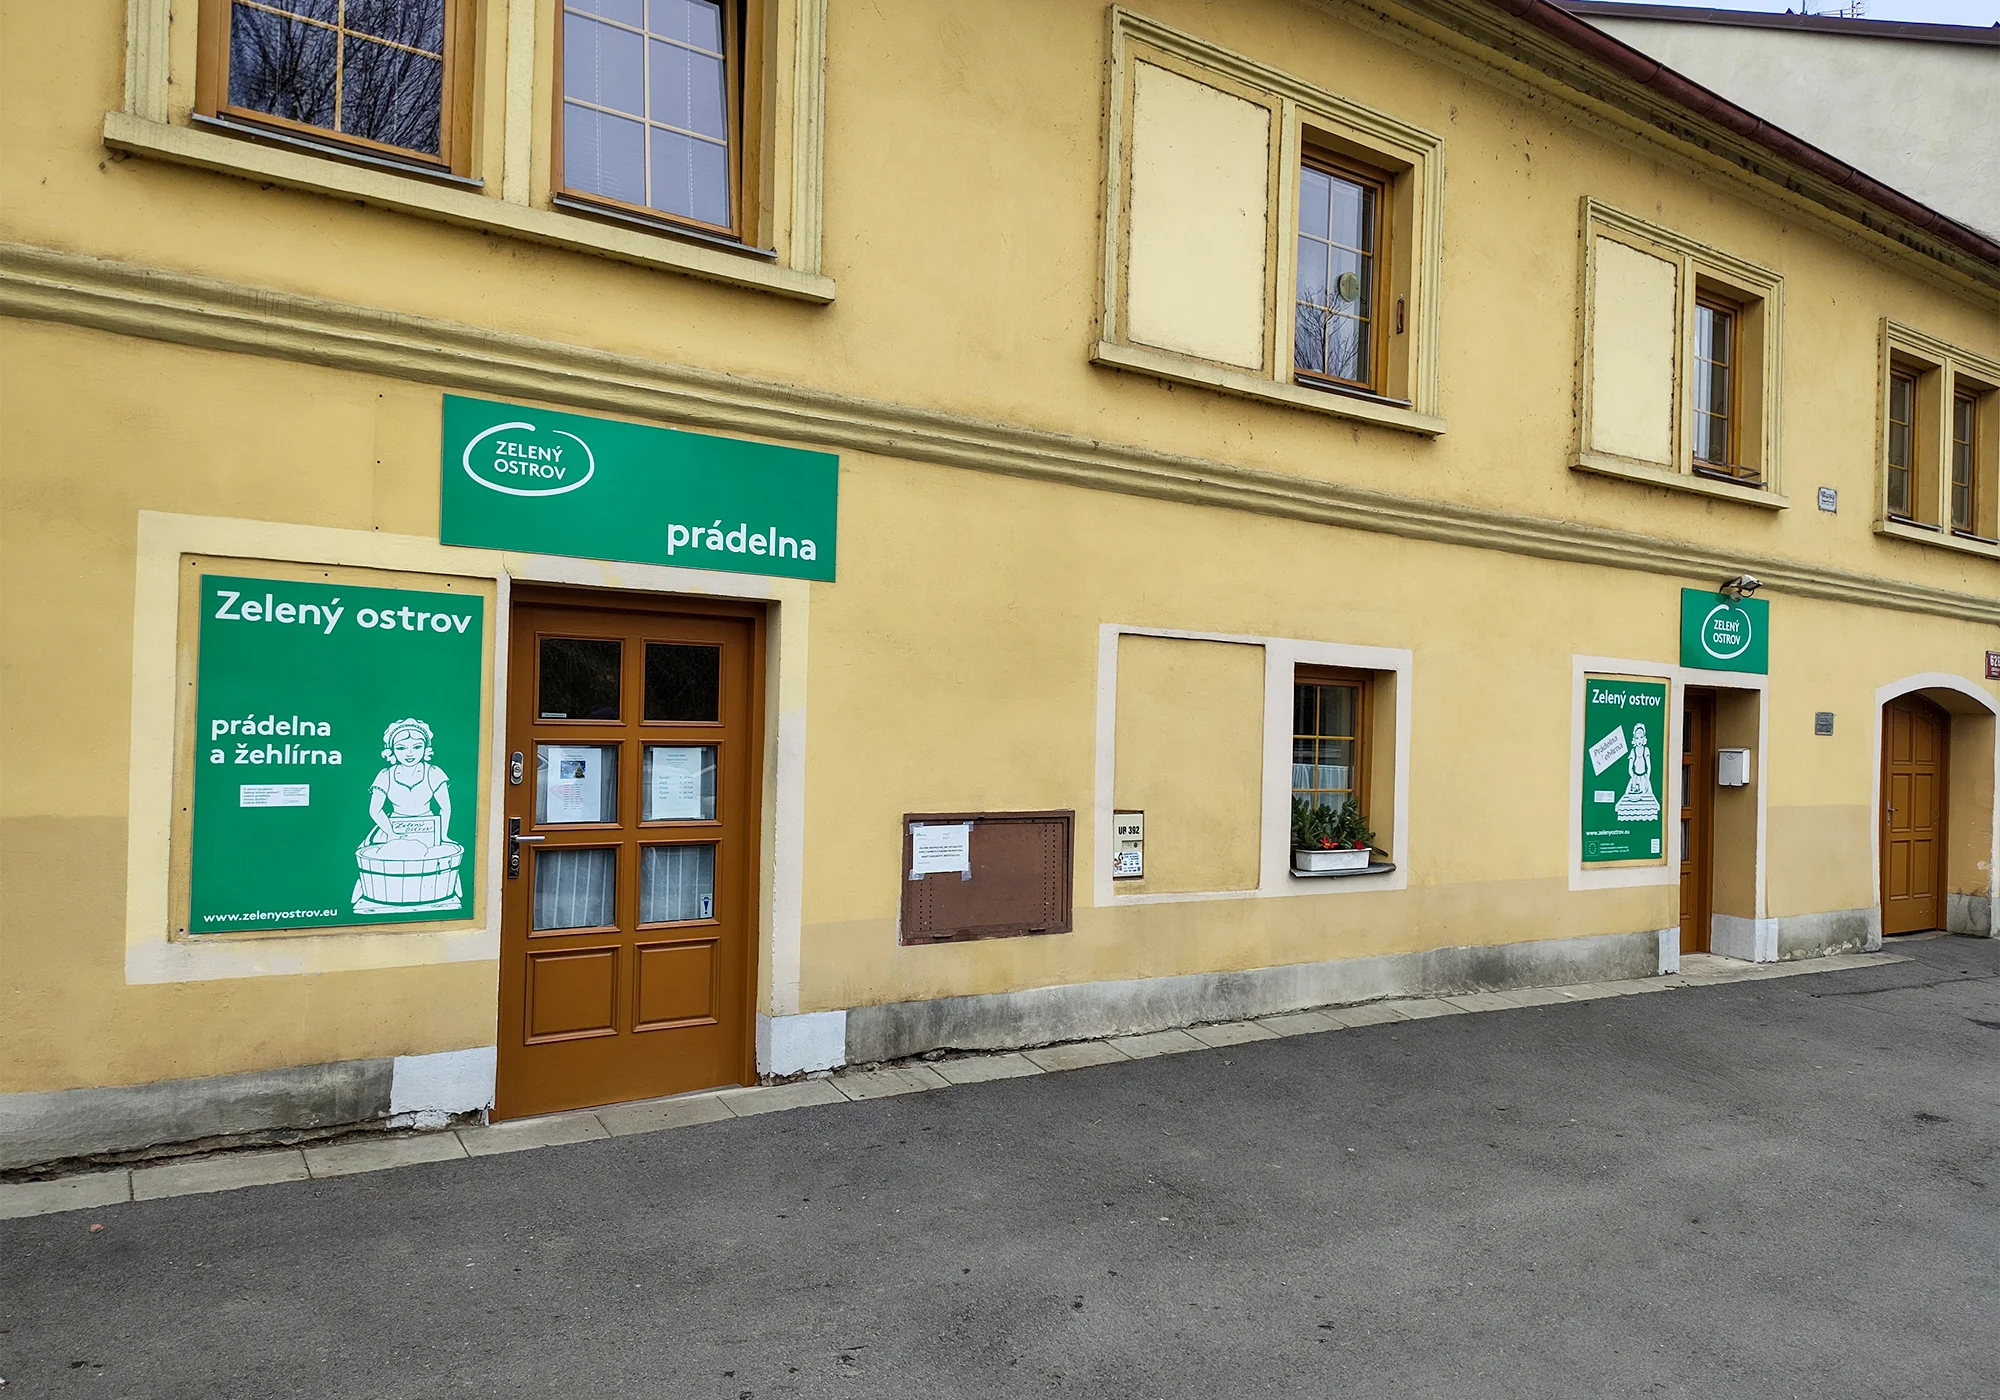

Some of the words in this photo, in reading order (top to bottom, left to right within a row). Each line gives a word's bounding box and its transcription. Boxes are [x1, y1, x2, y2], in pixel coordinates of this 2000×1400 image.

[496, 441, 563, 463] ZELENÝ
[494, 458, 566, 480] OSTROV
[667, 520, 816, 560] prádelna
[215, 590, 344, 634] Zelený
[356, 606, 472, 634] ostrov
[1713, 619, 1740, 633] ZELENÝ
[1713, 632, 1741, 645] OSTROV
[1592, 688, 1627, 709] Zelený
[1629, 693, 1661, 707] ostrov
[211, 714, 331, 741] prádelna
[210, 749, 225, 764] a
[234, 743, 342, 765] žehlírna
[1118, 826, 1127, 835] UR
[1128, 825, 1140, 835] 392
[203, 909, 338, 922] www.zelenyostrov.eu
